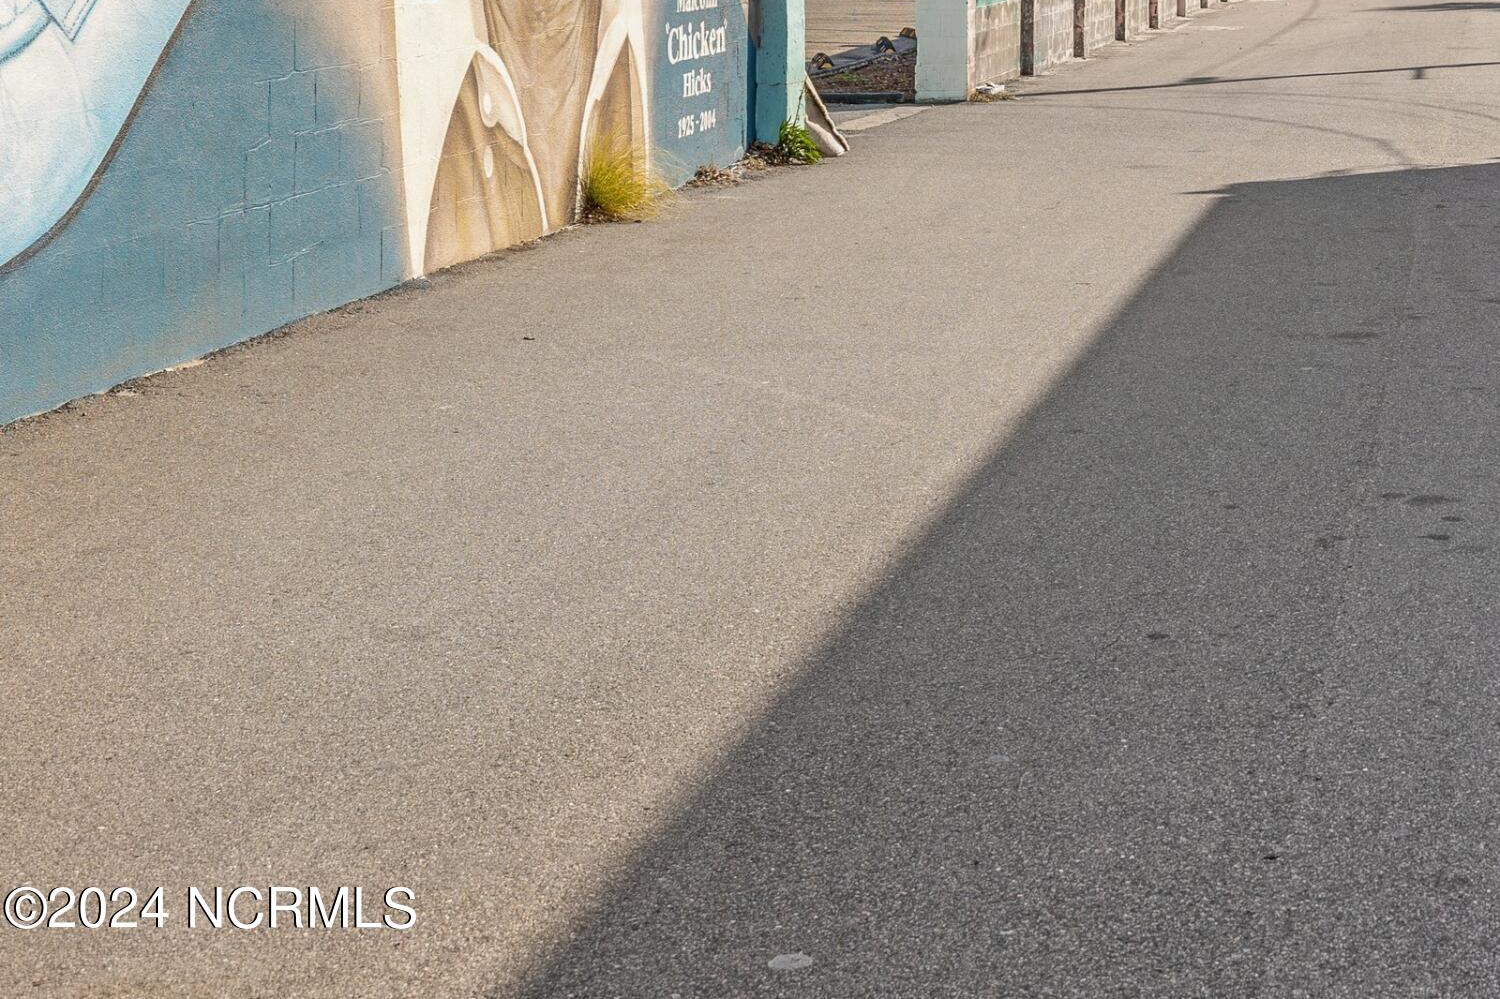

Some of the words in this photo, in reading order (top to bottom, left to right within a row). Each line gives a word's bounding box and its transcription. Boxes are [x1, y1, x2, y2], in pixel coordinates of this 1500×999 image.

[682, 67, 712, 98] Hicks
[678, 114, 695, 139] 1925
[700, 108, 717, 132] 2004
